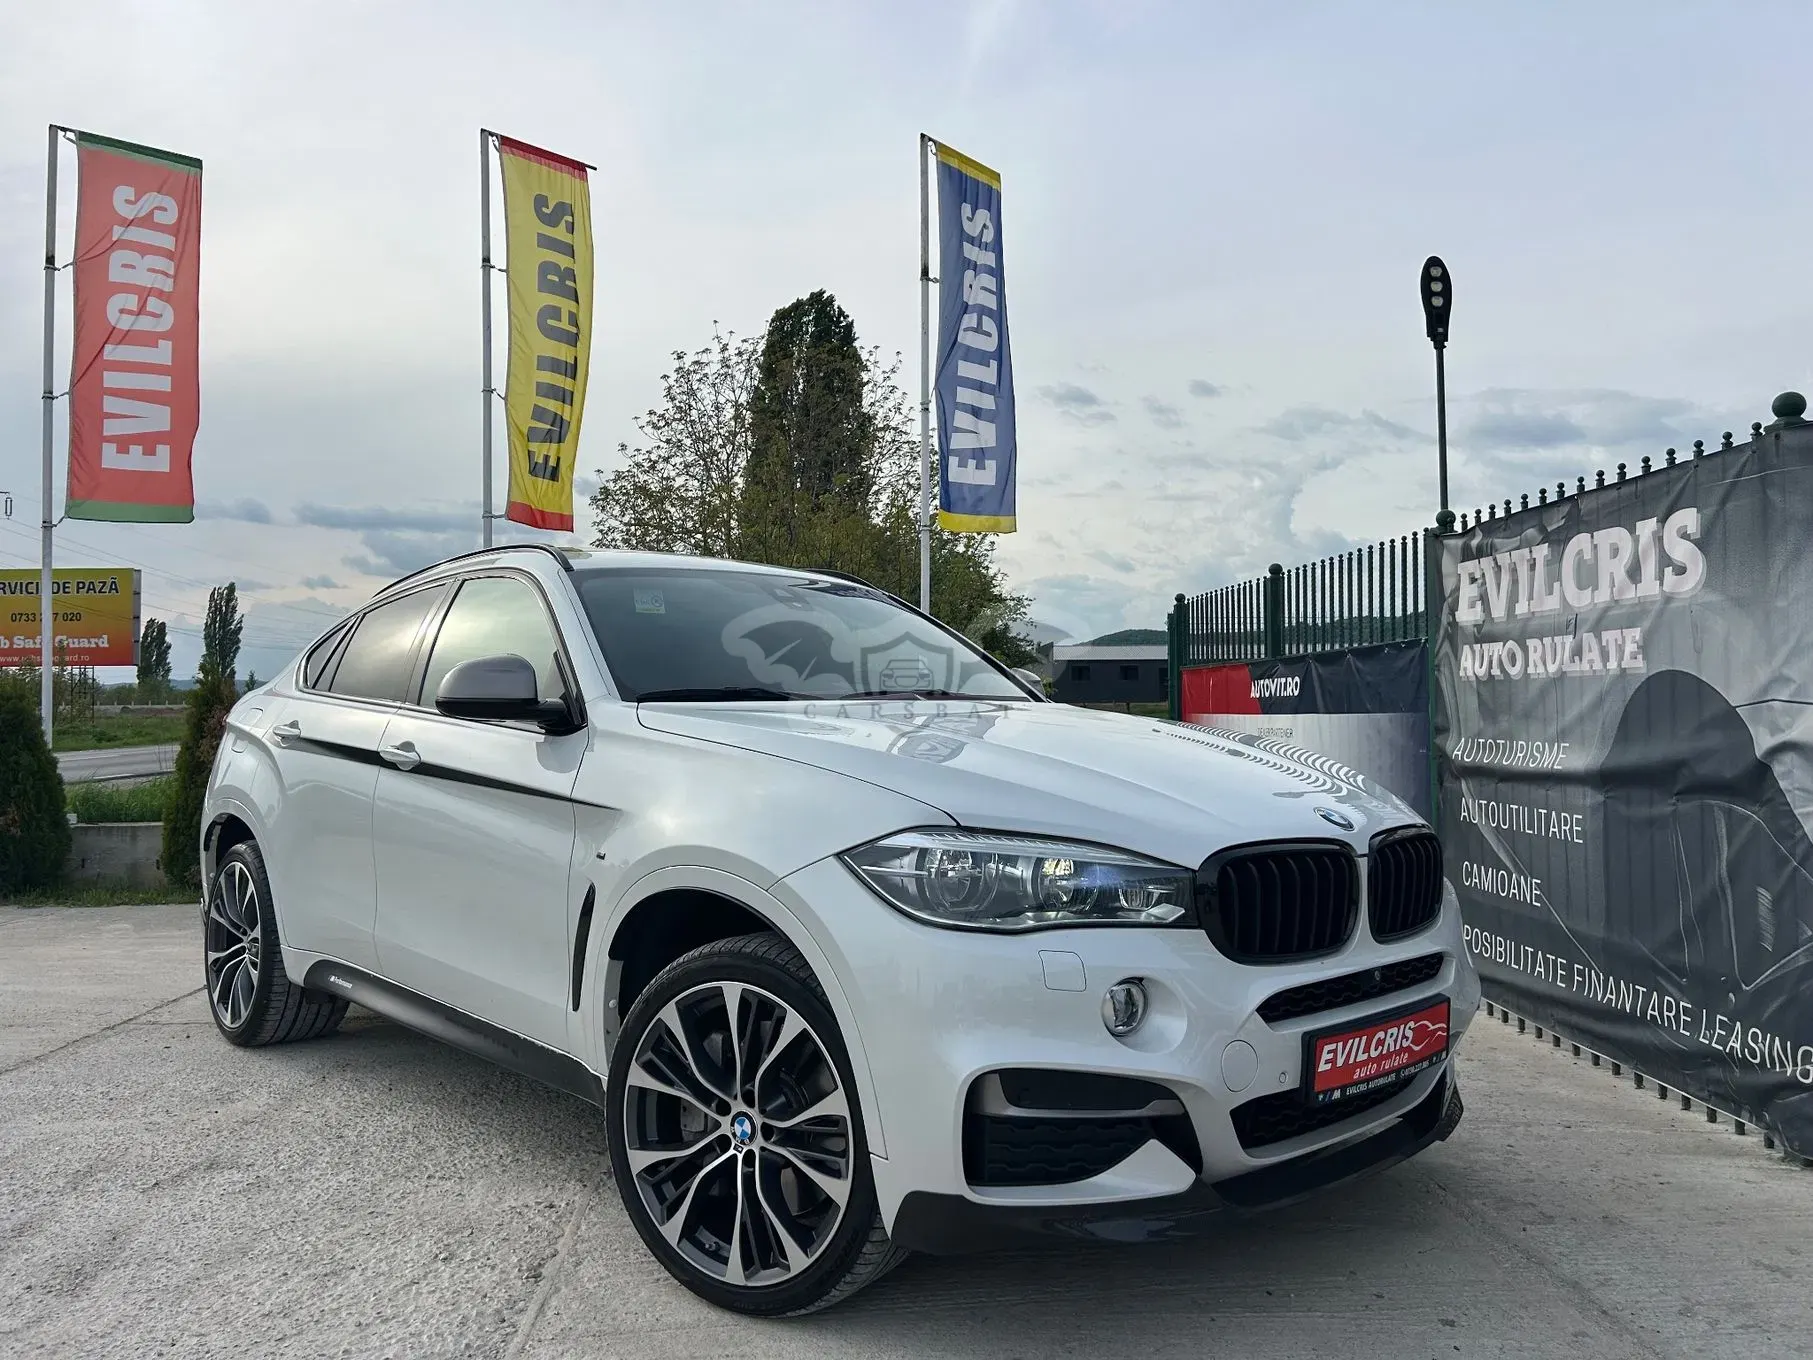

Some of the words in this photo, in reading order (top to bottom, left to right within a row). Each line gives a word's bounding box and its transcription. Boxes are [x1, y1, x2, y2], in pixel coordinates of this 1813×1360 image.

[102, 185, 179, 473] EVILCRIS
[527, 193, 580, 482] EVILCRIS
[949, 202, 999, 486] EVILCRIS
[52, 581, 71, 595] DE
[1456, 508, 1704, 622] EVILCRIS
[11, 612, 37, 622] 0733
[62, 612, 82, 622] 020
[13, 635, 43, 649] Saf
[55, 634, 109, 648] Guard
[1459, 639, 1524, 679] AUTO
[1526, 627, 1644, 673] RULATE
[1250, 676, 1300, 698] AUTOVIT.RO
[1452, 737, 1569, 769] AUTOTURISME
[1460, 797, 1584, 844] AUTOUTILITARE
[1462, 861, 1542, 907] CAMIOANE
[1463, 924, 1566, 988] POSIBILITATE
[1572, 963, 1692, 1037] FINANTARE
[1699, 1009, 1813, 1084] LEASING
[1317, 1020, 1415, 1072] EVILCRIS
[1353, 1062, 1376, 1079] auto
[1380, 1051, 1409, 1072] rulate
